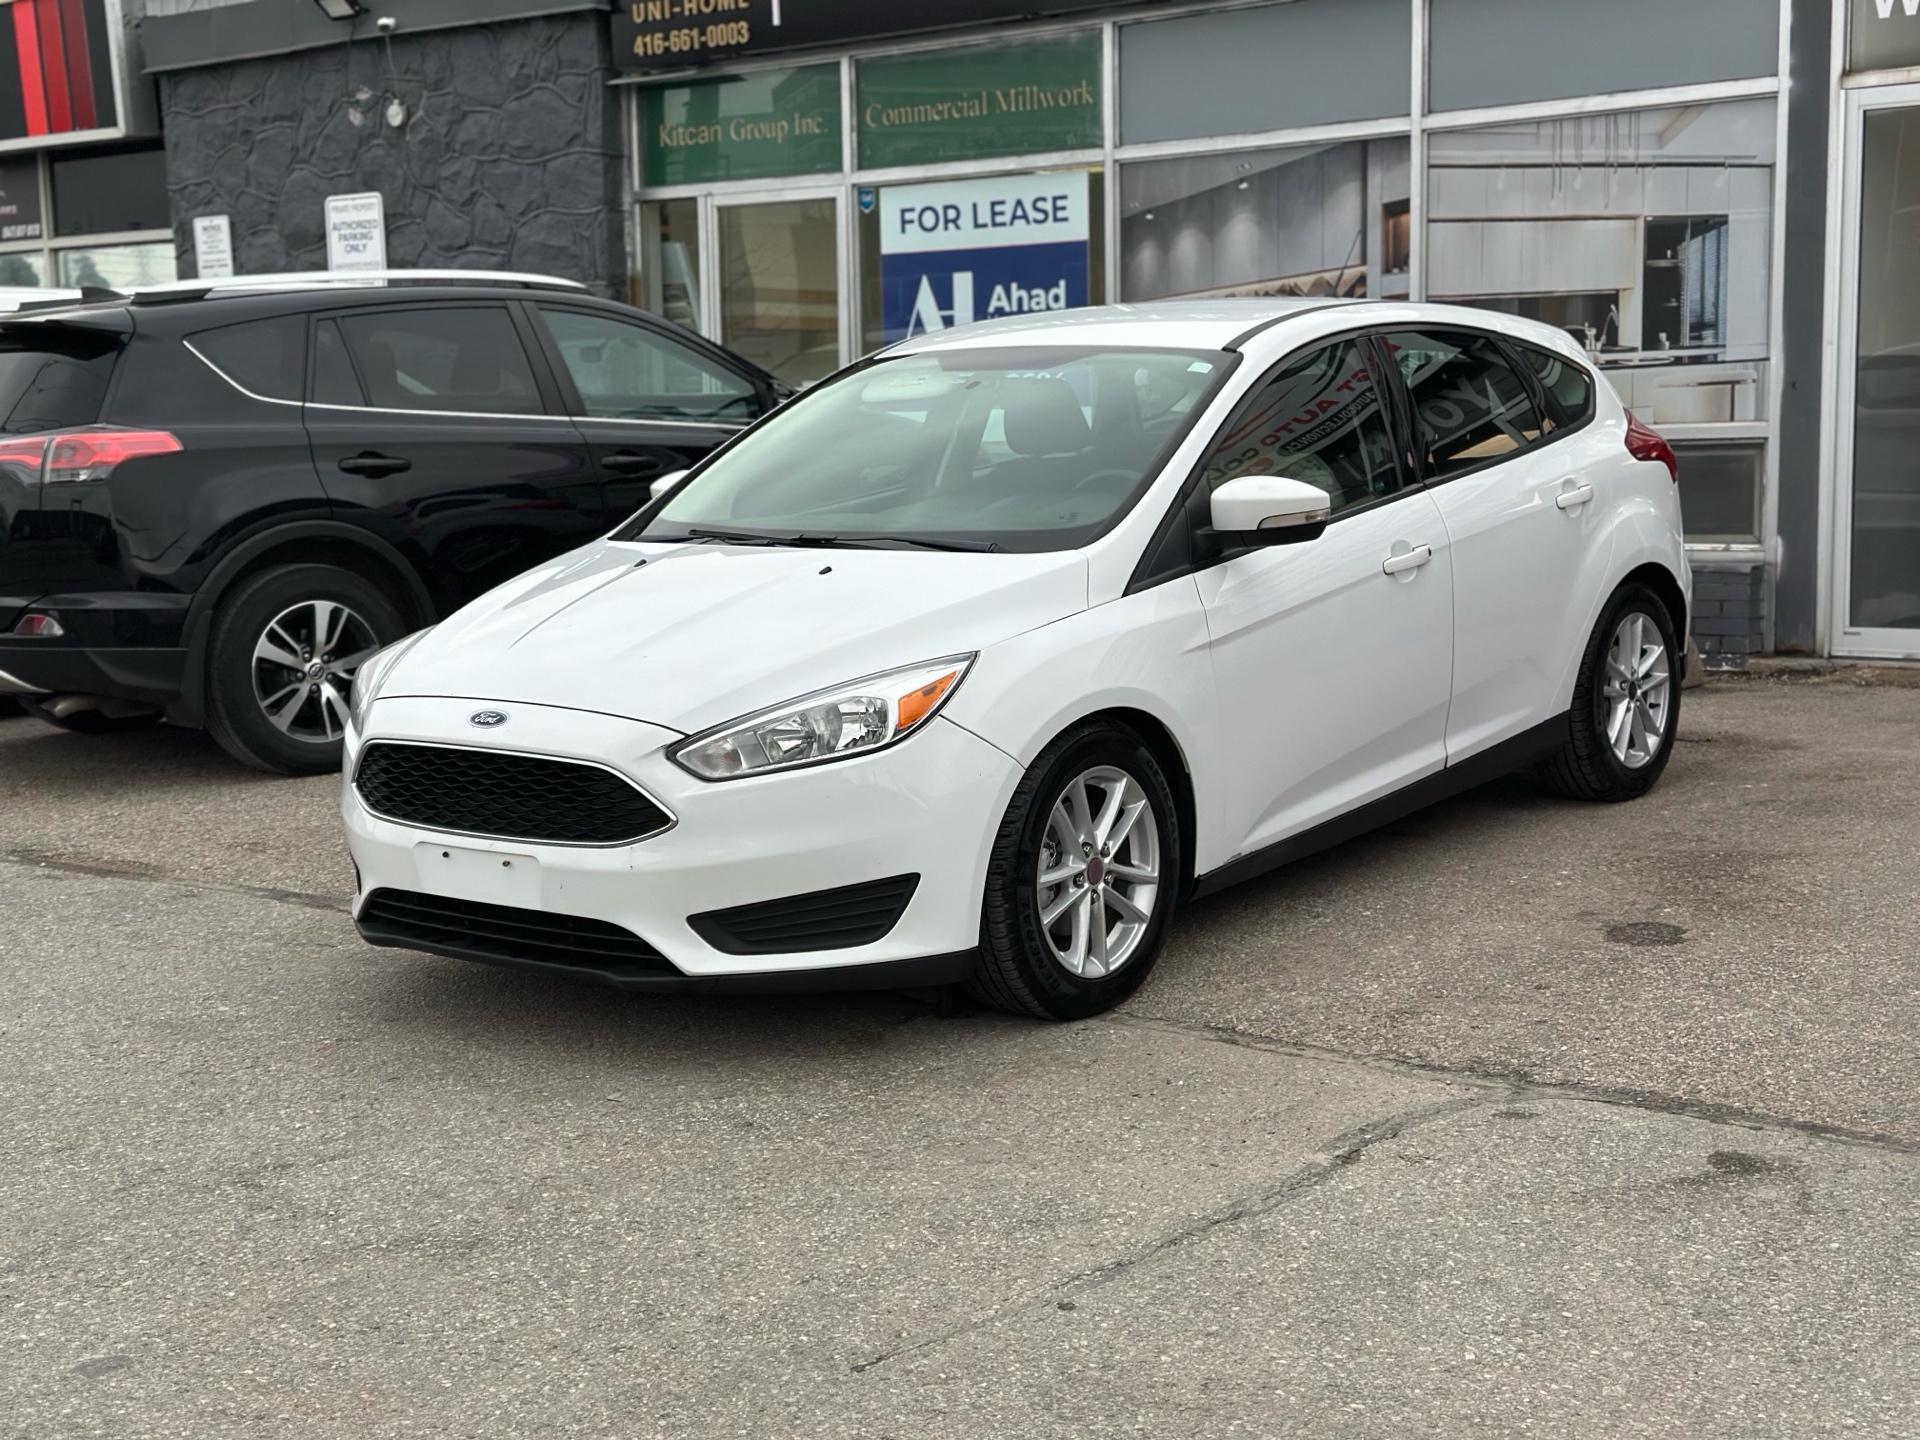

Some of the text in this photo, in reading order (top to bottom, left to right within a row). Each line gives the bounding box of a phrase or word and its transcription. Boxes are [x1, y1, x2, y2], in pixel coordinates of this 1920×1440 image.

[633, 20, 750, 57] 416-661-0003
[865, 79, 1094, 127] Commercial Millwork
[659, 112, 829, 147] Kitcan Group Inc.
[332, 219, 379, 232] AUTHORIZED
[900, 194, 1070, 235] FOR LEASE
[338, 230, 374, 243] PARKING
[344, 243, 368, 255] ONLY
[987, 279, 1067, 315] Ahad
[474, 711, 501, 724] Ford
